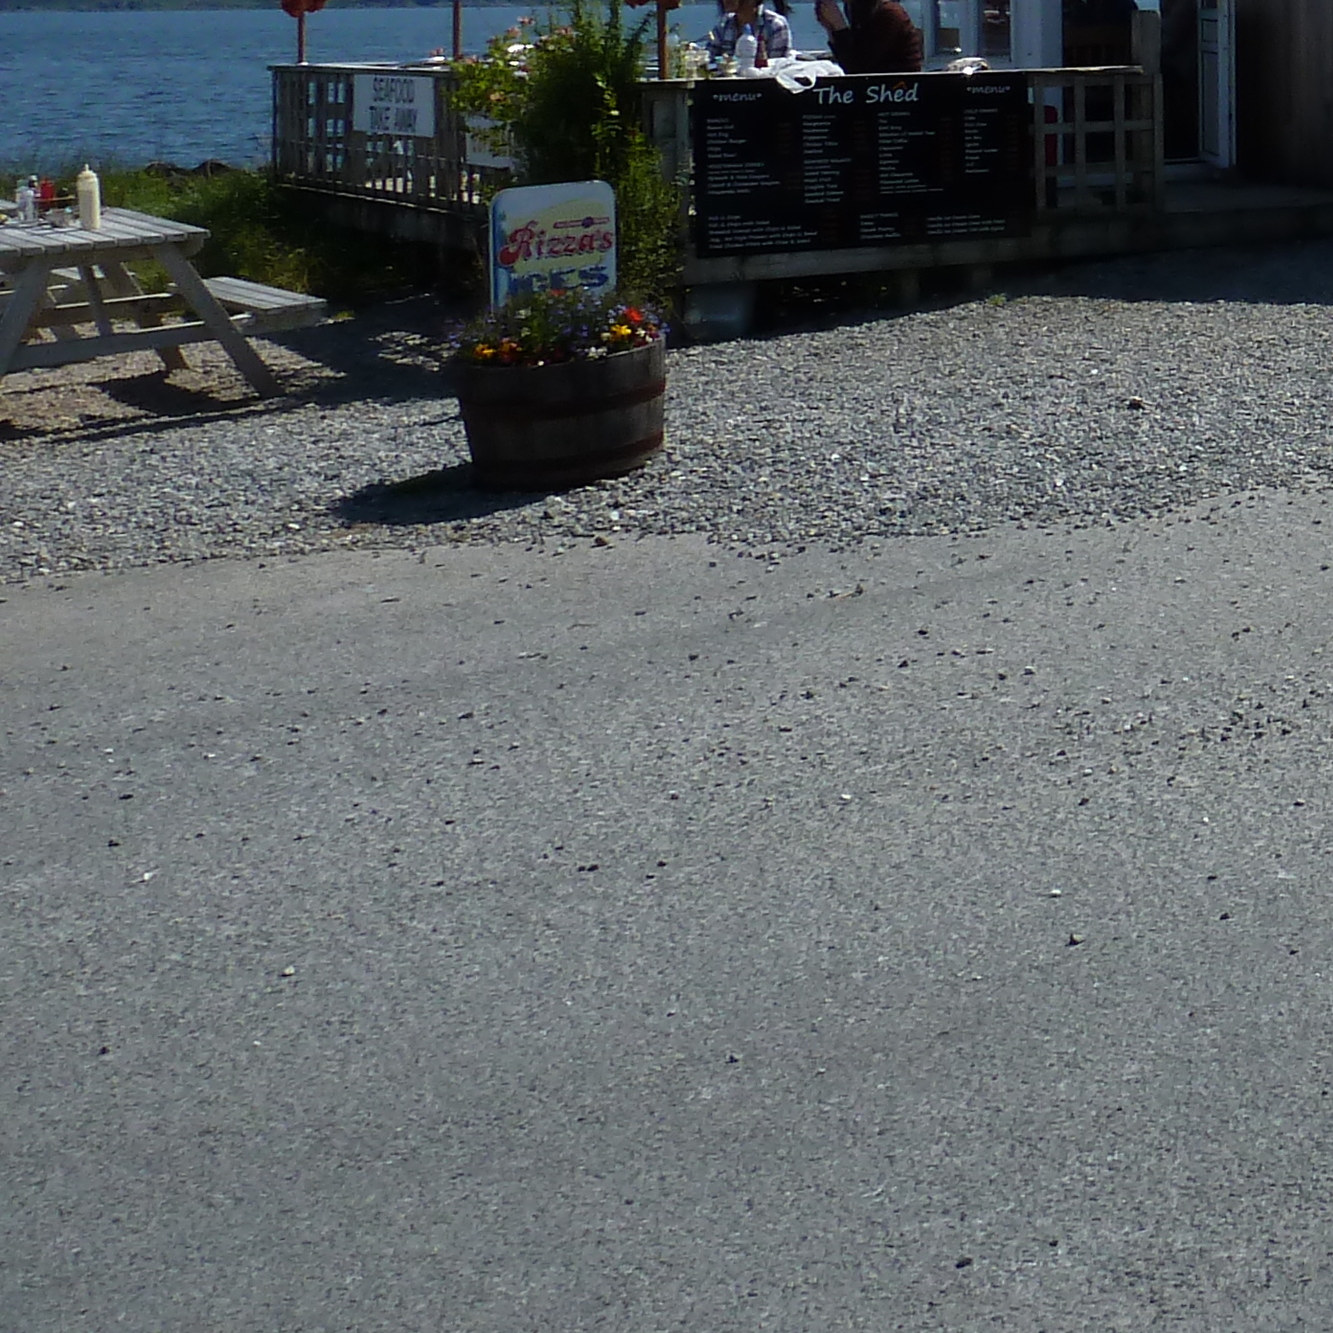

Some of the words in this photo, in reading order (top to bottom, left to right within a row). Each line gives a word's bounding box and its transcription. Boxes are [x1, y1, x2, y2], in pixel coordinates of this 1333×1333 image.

[372, 74, 416, 104] SEAFOOD
[718, 92, 757, 102] menu
[812, 85, 854, 104] The
[865, 82, 919, 103] Shed
[970, 85, 1006, 95] menu
[498, 219, 613, 266] Rizza's
